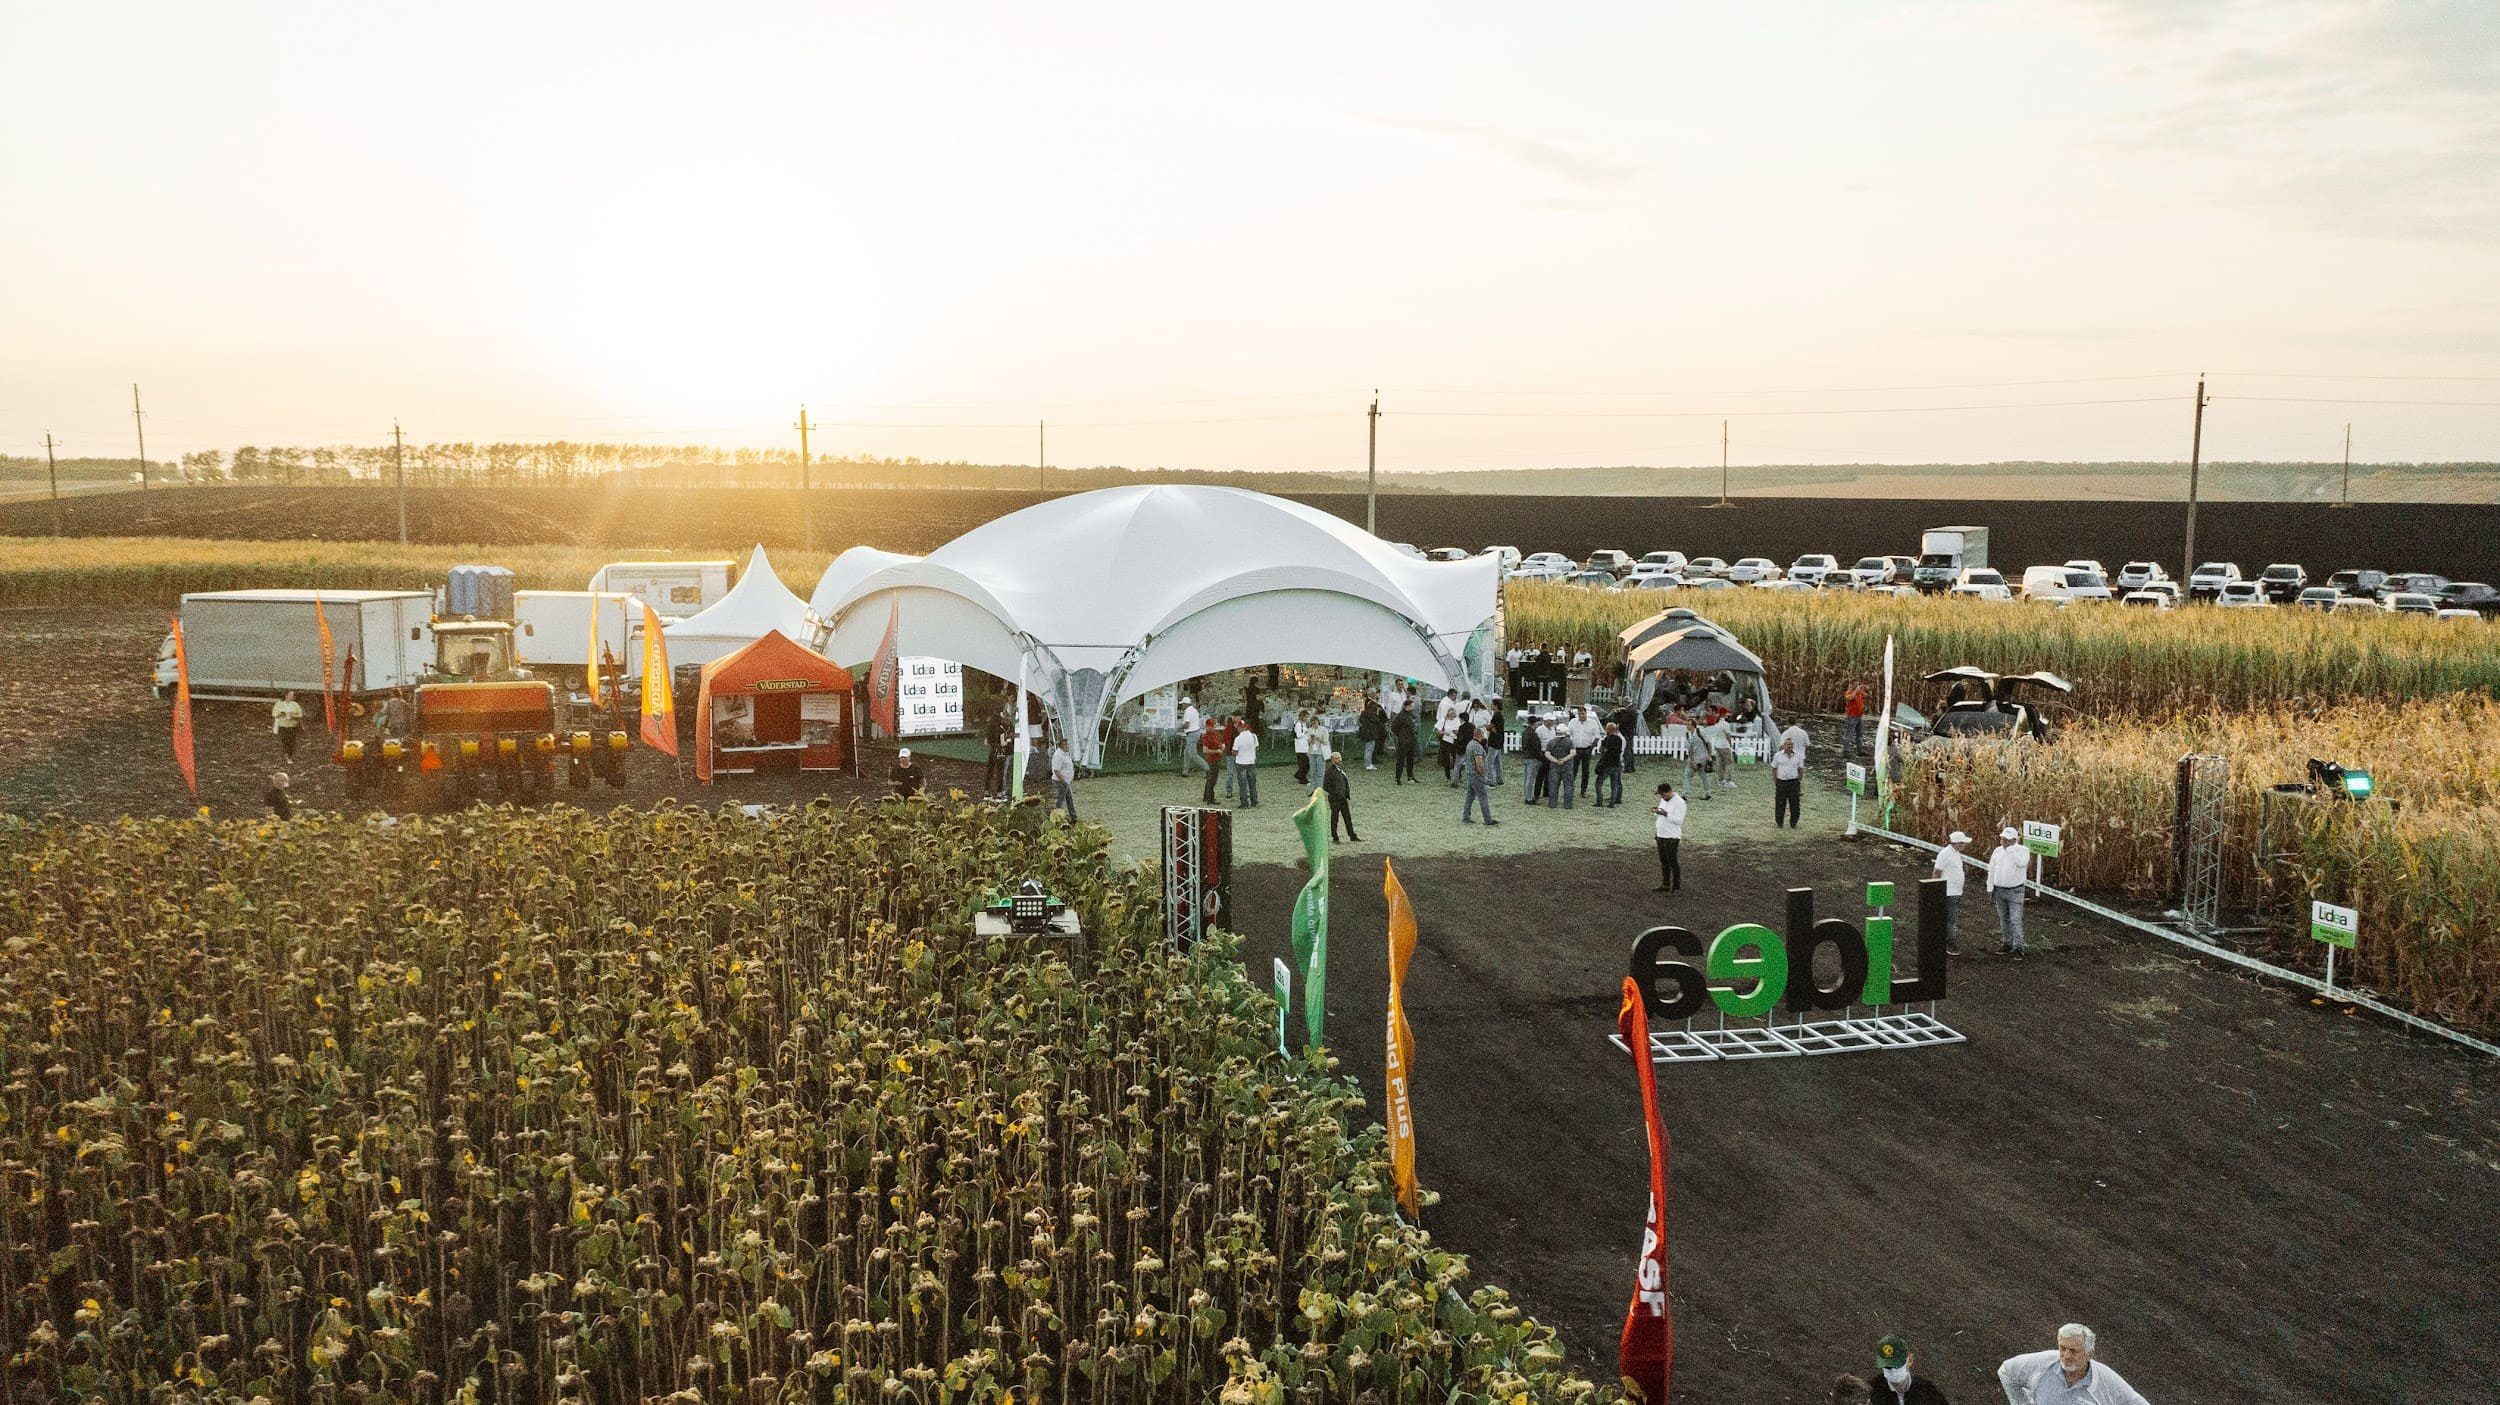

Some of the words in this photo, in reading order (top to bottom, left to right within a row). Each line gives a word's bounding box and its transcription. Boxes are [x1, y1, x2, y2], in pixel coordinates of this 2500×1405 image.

[912, 664, 935, 676] Lidea
[904, 684, 926, 695] Lidea
[935, 683, 957, 694] Lidea
[913, 703, 936, 715] Lidea
[2028, 824, 2052, 839] Lidea
[2319, 906, 2347, 926] Lidea
[1391, 1077, 1411, 1140] Plus
